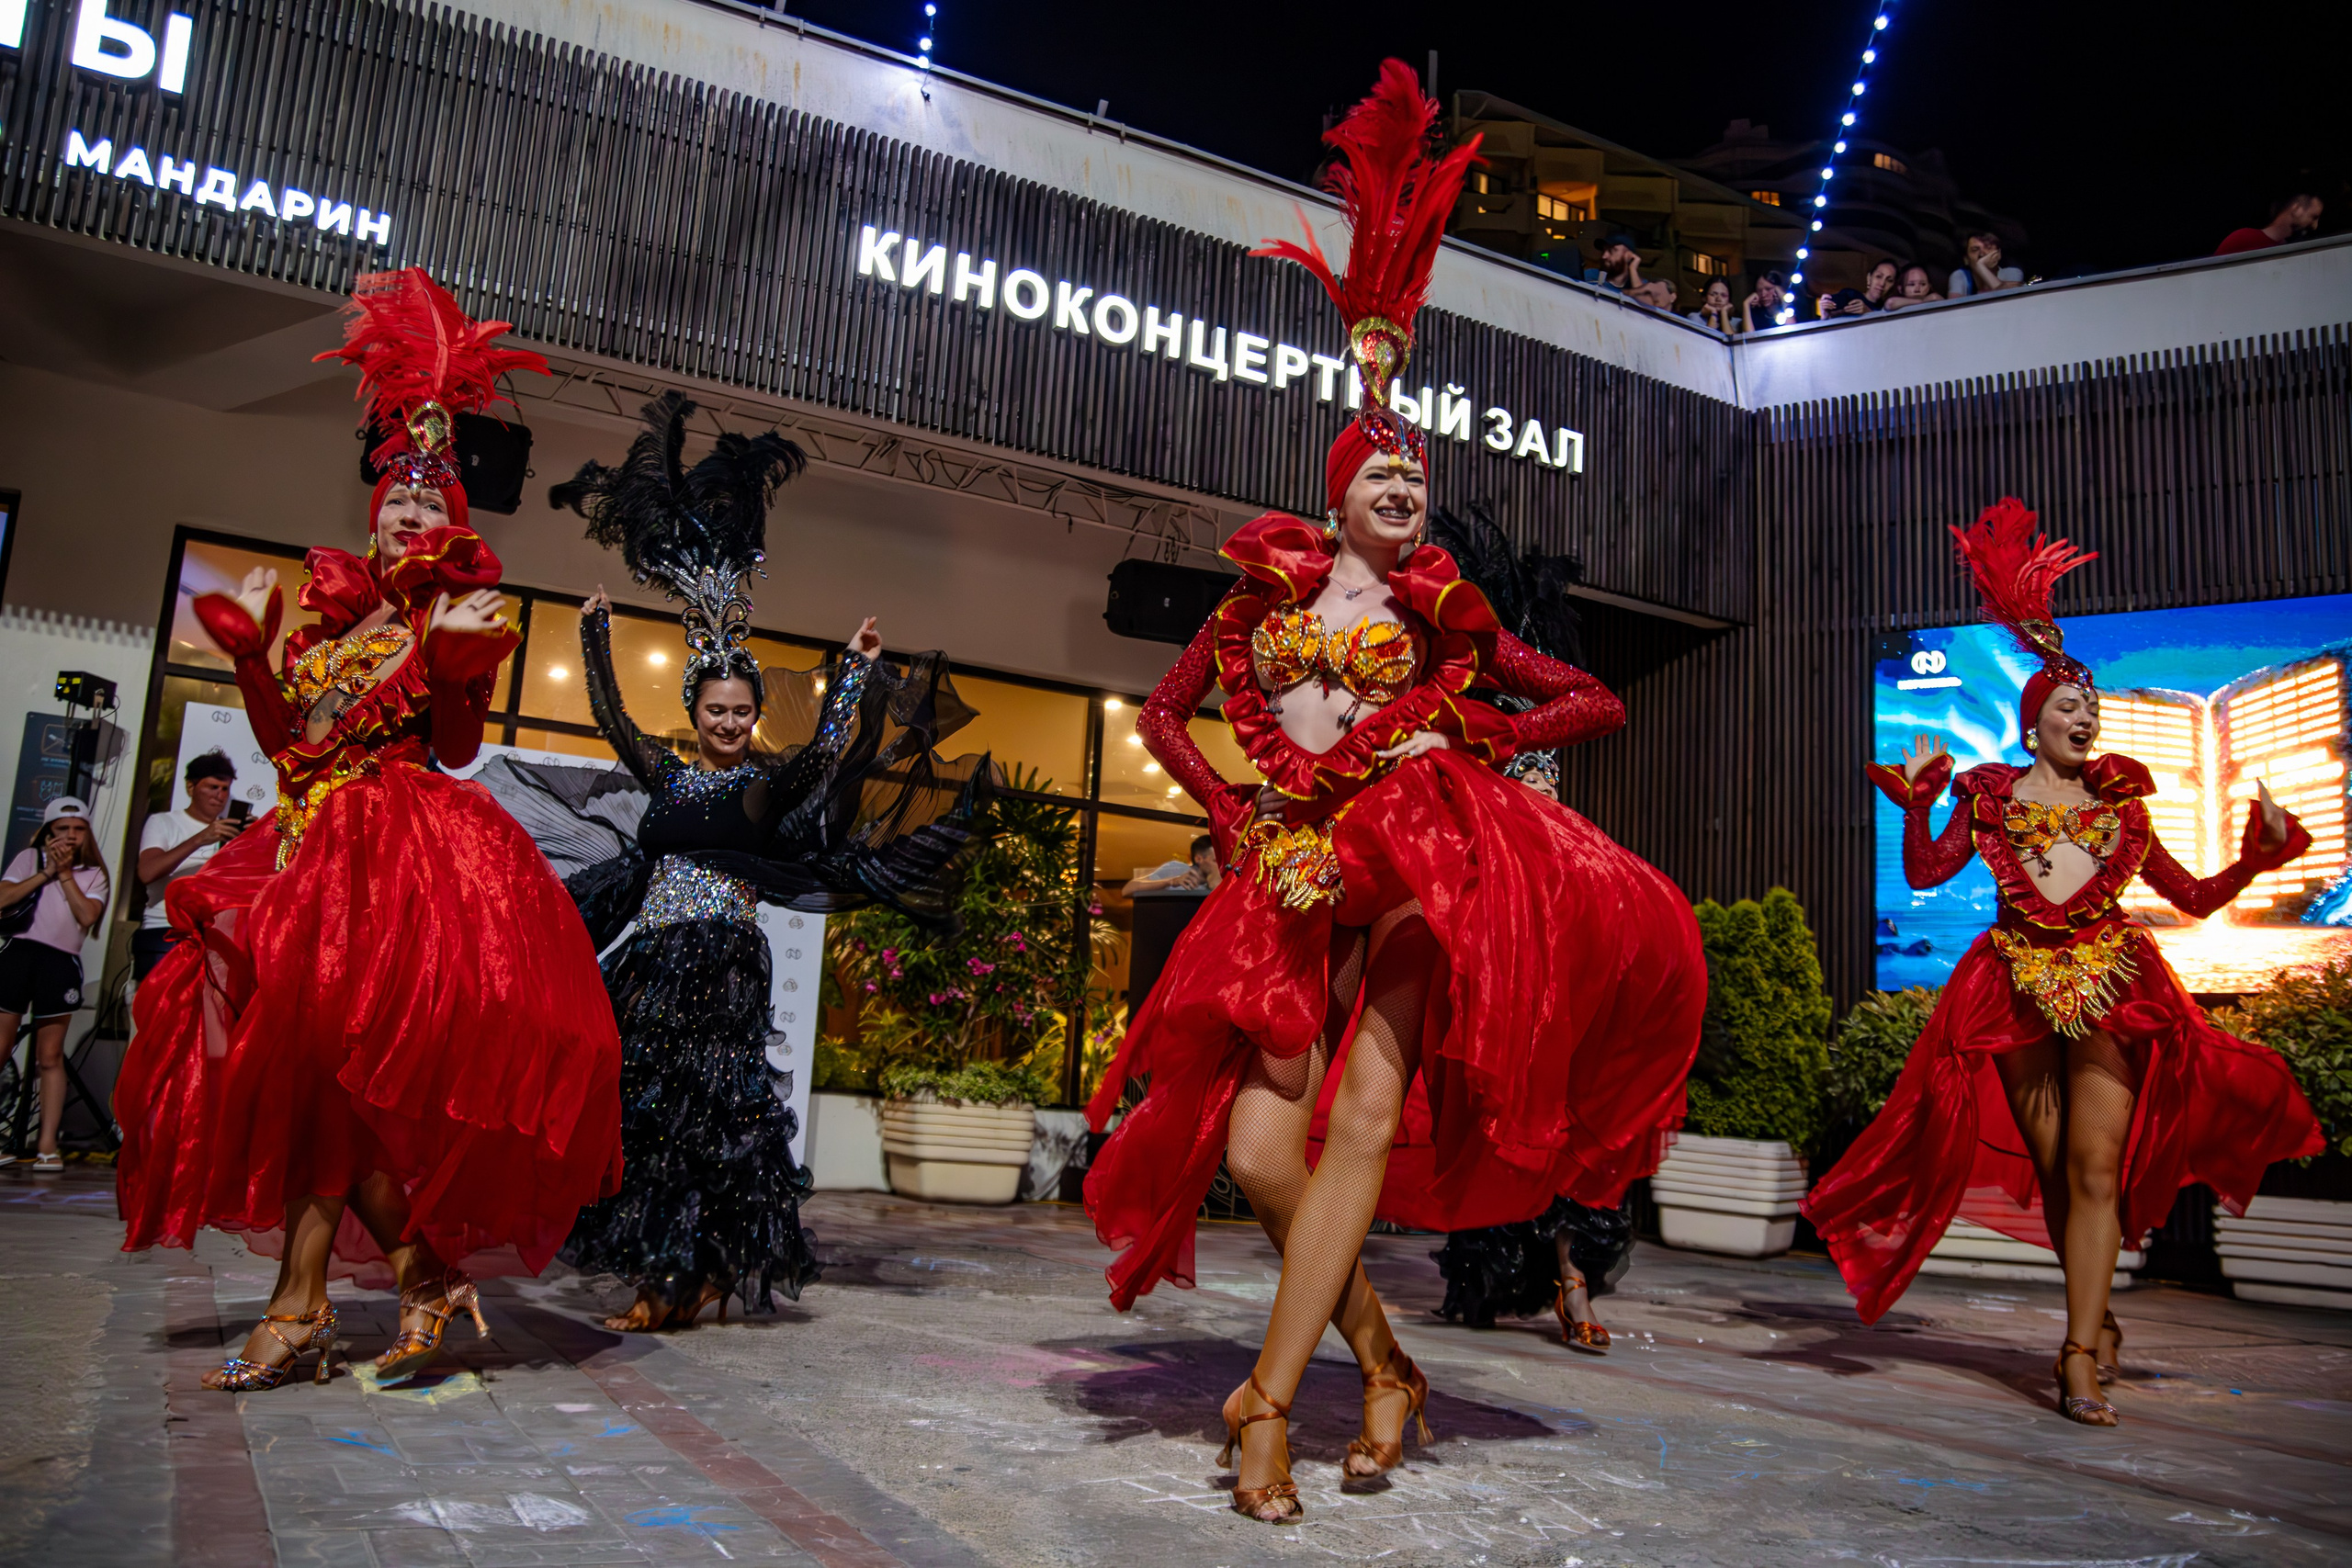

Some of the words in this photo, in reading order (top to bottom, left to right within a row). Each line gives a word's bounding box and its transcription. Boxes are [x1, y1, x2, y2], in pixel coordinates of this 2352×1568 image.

[0, 0, 192, 94] Ы
[65, 128, 392, 247] МАНДАРИН
[1484, 406, 1585, 474] ЗАЛ
